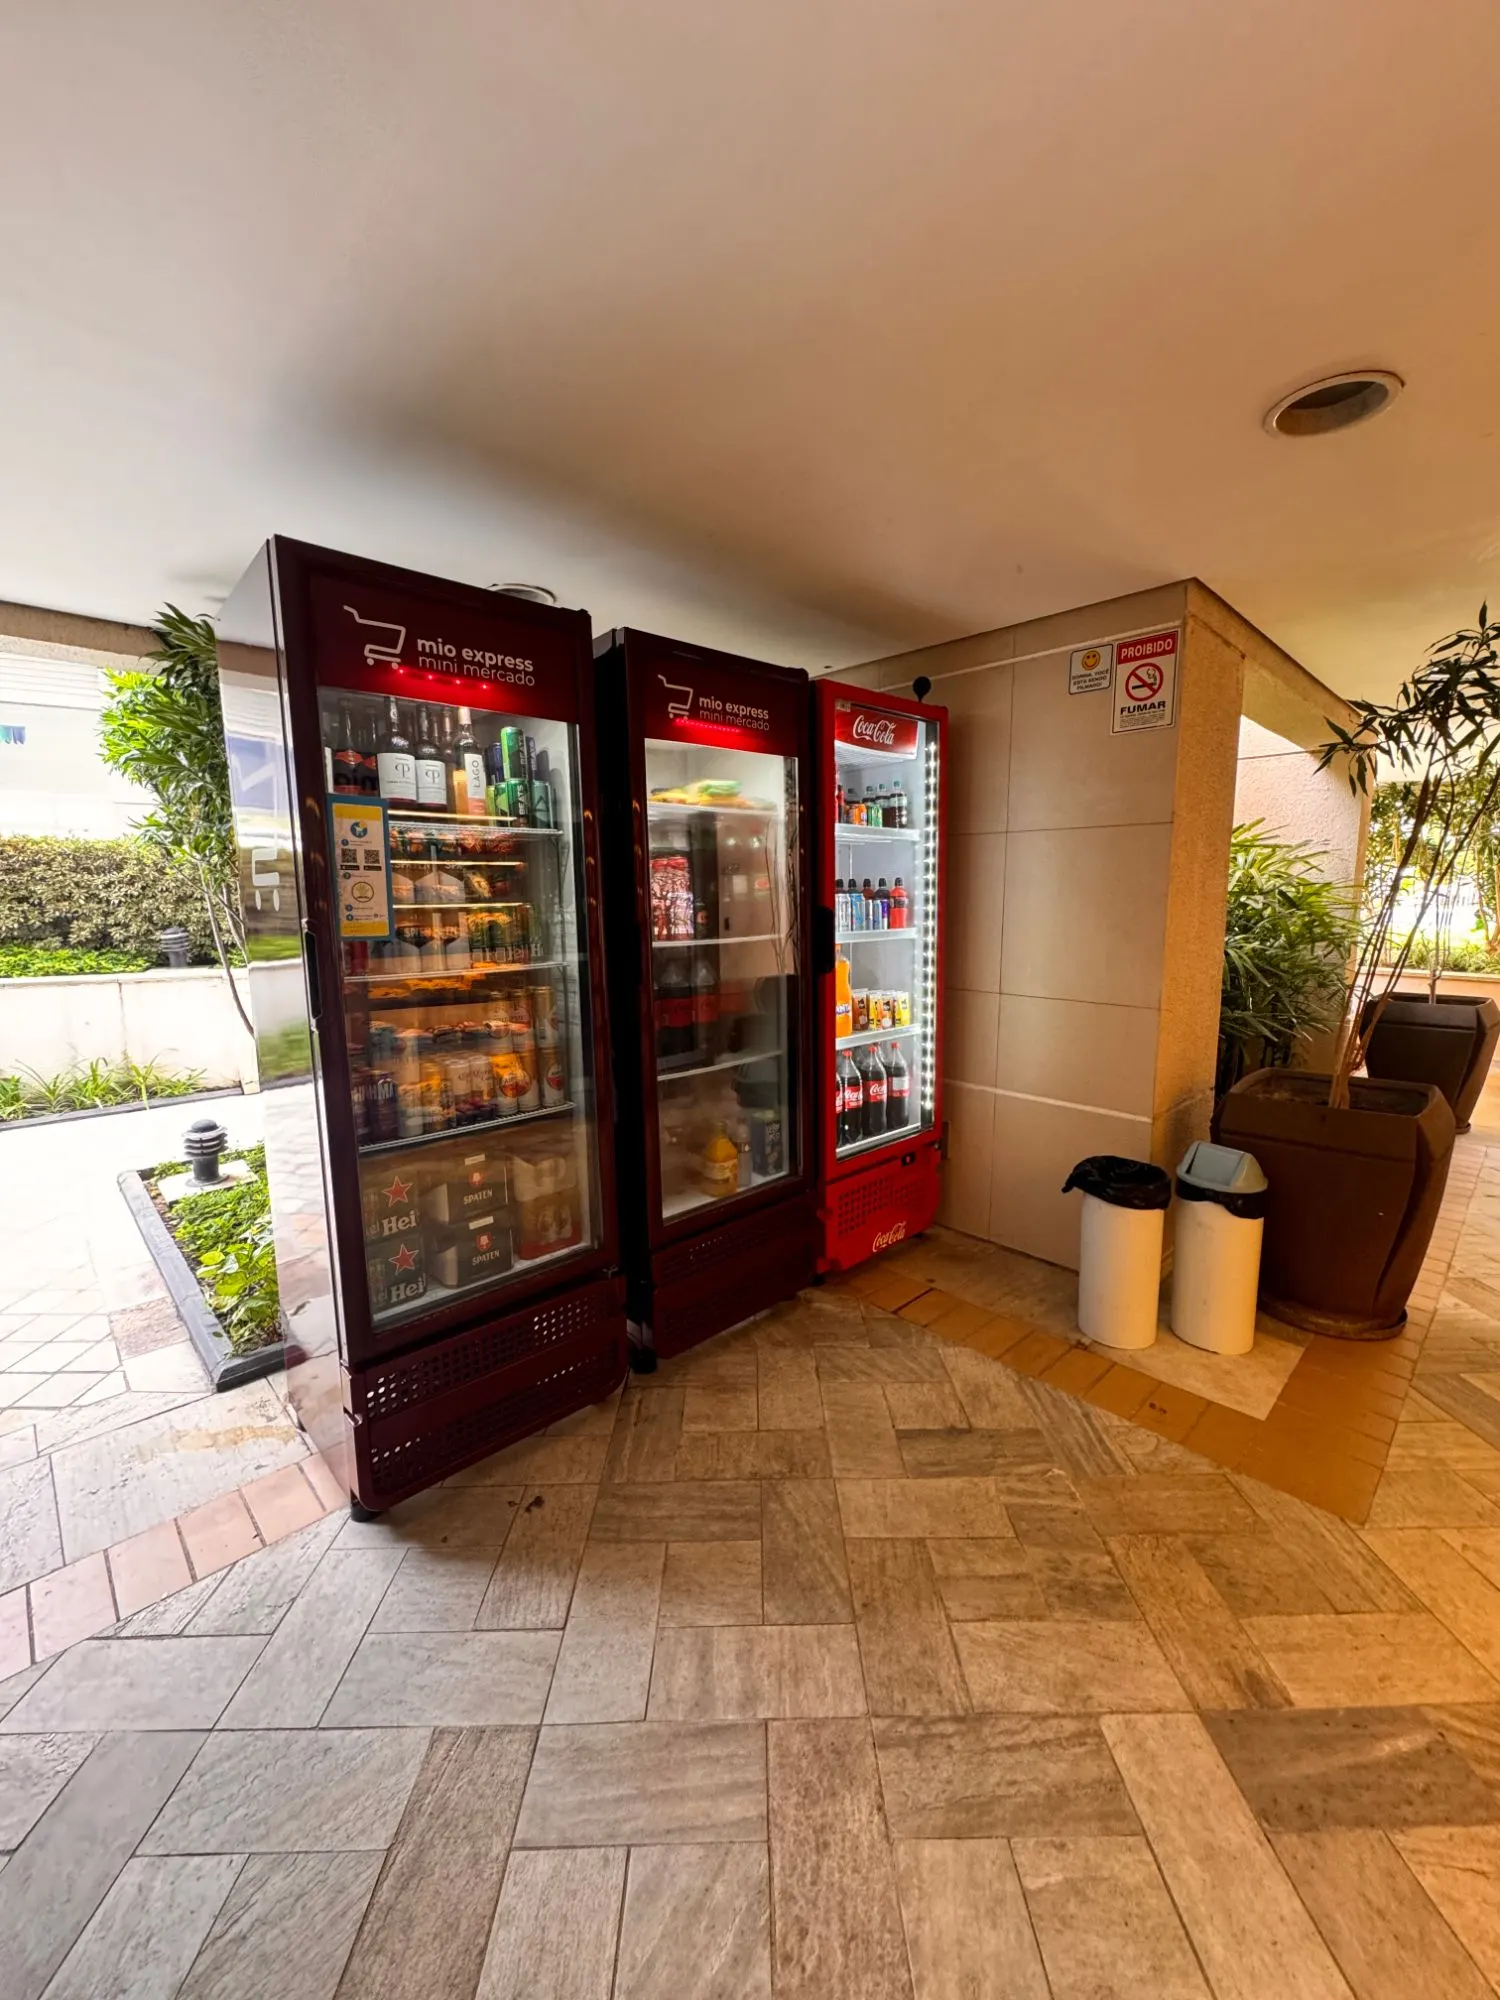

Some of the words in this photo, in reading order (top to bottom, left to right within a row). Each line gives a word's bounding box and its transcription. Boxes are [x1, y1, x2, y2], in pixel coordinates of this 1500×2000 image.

[417, 638, 457, 658] mio
[461, 648, 534, 673] express
[1121, 638, 1173, 660] PROIBIDO
[419, 656, 458, 674] mini
[463, 664, 536, 687] mercado
[699, 695, 723, 710] mio
[725, 702, 769, 720] express
[1120, 701, 1166, 715] FUMAR
[726, 714, 770, 731] mercado
[852, 714, 897, 745] Coca-Cola
[472, 759, 481, 789] LAGO
[463, 1188, 493, 1205] SPATEN
[471, 1250, 500, 1266] SPATEN
